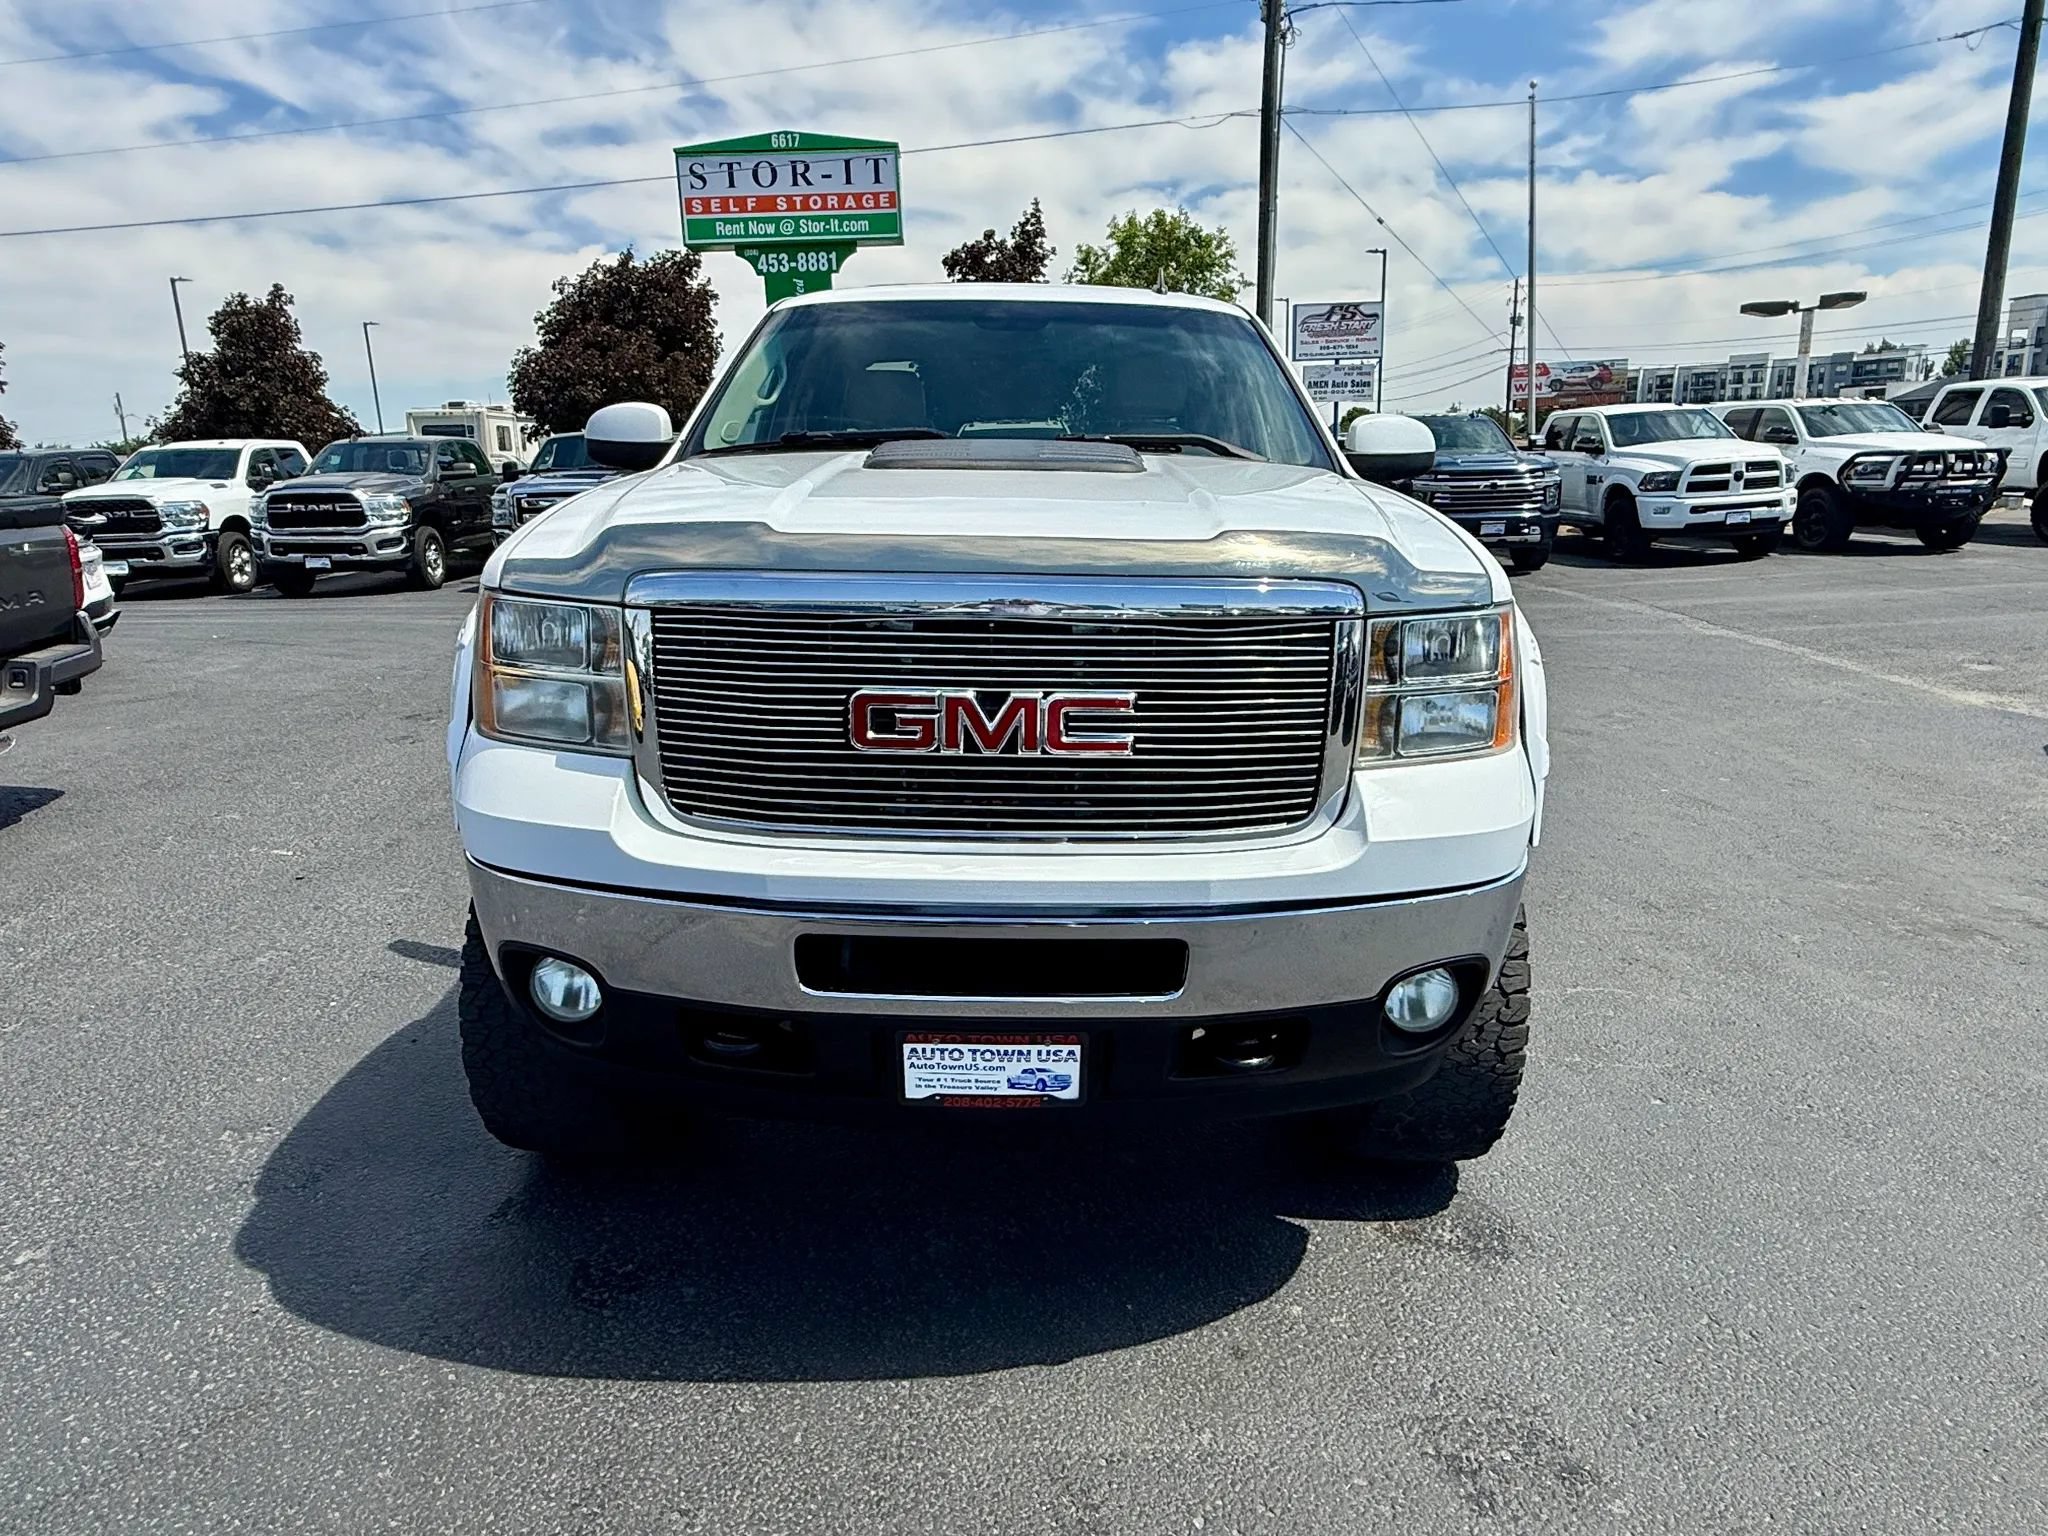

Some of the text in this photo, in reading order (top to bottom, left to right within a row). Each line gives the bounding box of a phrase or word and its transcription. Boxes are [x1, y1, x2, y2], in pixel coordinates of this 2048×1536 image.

[771, 133, 800, 149] 6617
[688, 157, 888, 190] STOR-IT
[691, 193, 891, 213] SELF STORAGE
[715, 217, 870, 236] Rent Now @ Stor-It.com
[757, 250, 838, 273] 453-8881
[1301, 319, 1376, 333] FRESH START
[1307, 379, 1371, 389] AMEN Auto Sales
[1514, 382, 1543, 393] WN
[292, 503, 333, 512] RAM
[849, 688, 1138, 755] GMC
[906, 1046, 1079, 1063] AUTO TOWN USA
[908, 1061, 1006, 1072] AutoTownUS.com
[943, 1096, 1041, 1108] 208-402-5772
